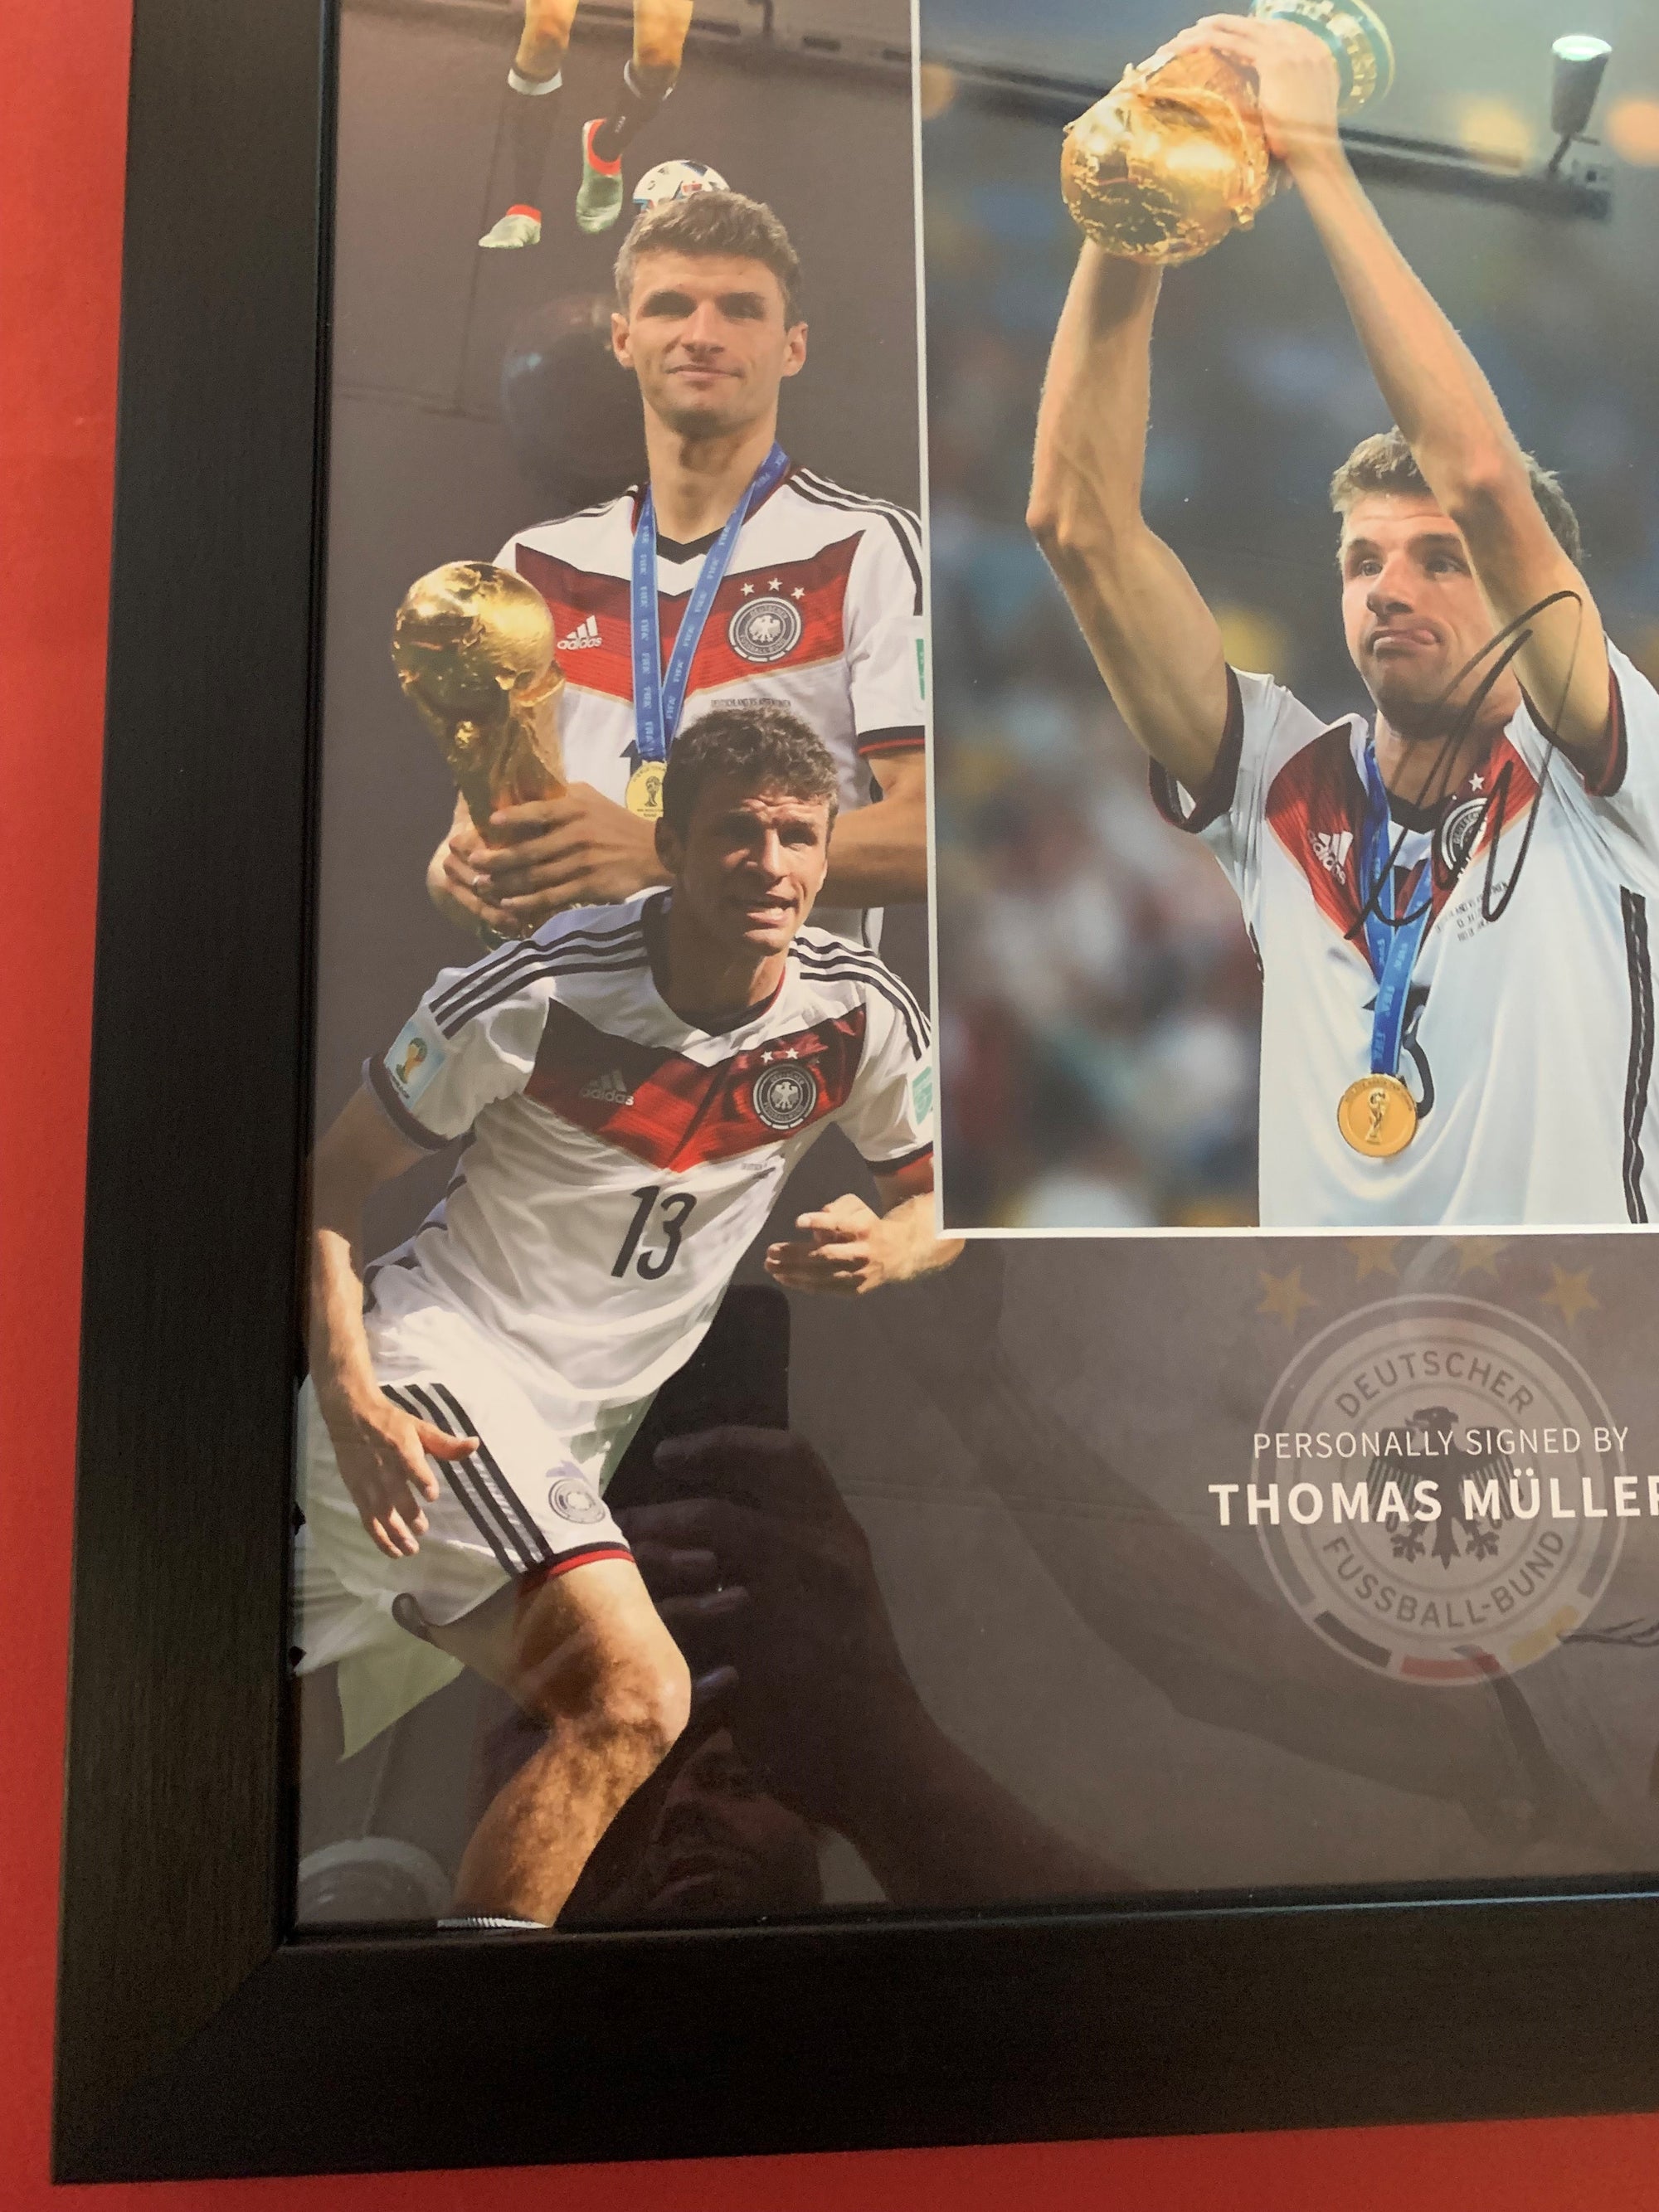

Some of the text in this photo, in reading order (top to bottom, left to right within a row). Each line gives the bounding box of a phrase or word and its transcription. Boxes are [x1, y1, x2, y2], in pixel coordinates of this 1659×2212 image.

[557, 637, 603, 651] adidas
[611, 1185, 698, 1280] 13
[1335, 1349, 1535, 1418] DEUTSCHER
[1253, 1426, 1628, 1459] PERSONALLY SIGNED BY
[1208, 1480, 1443, 1526] THOMAS
[1322, 1529, 1564, 1628] FUSSBALL-BUND
